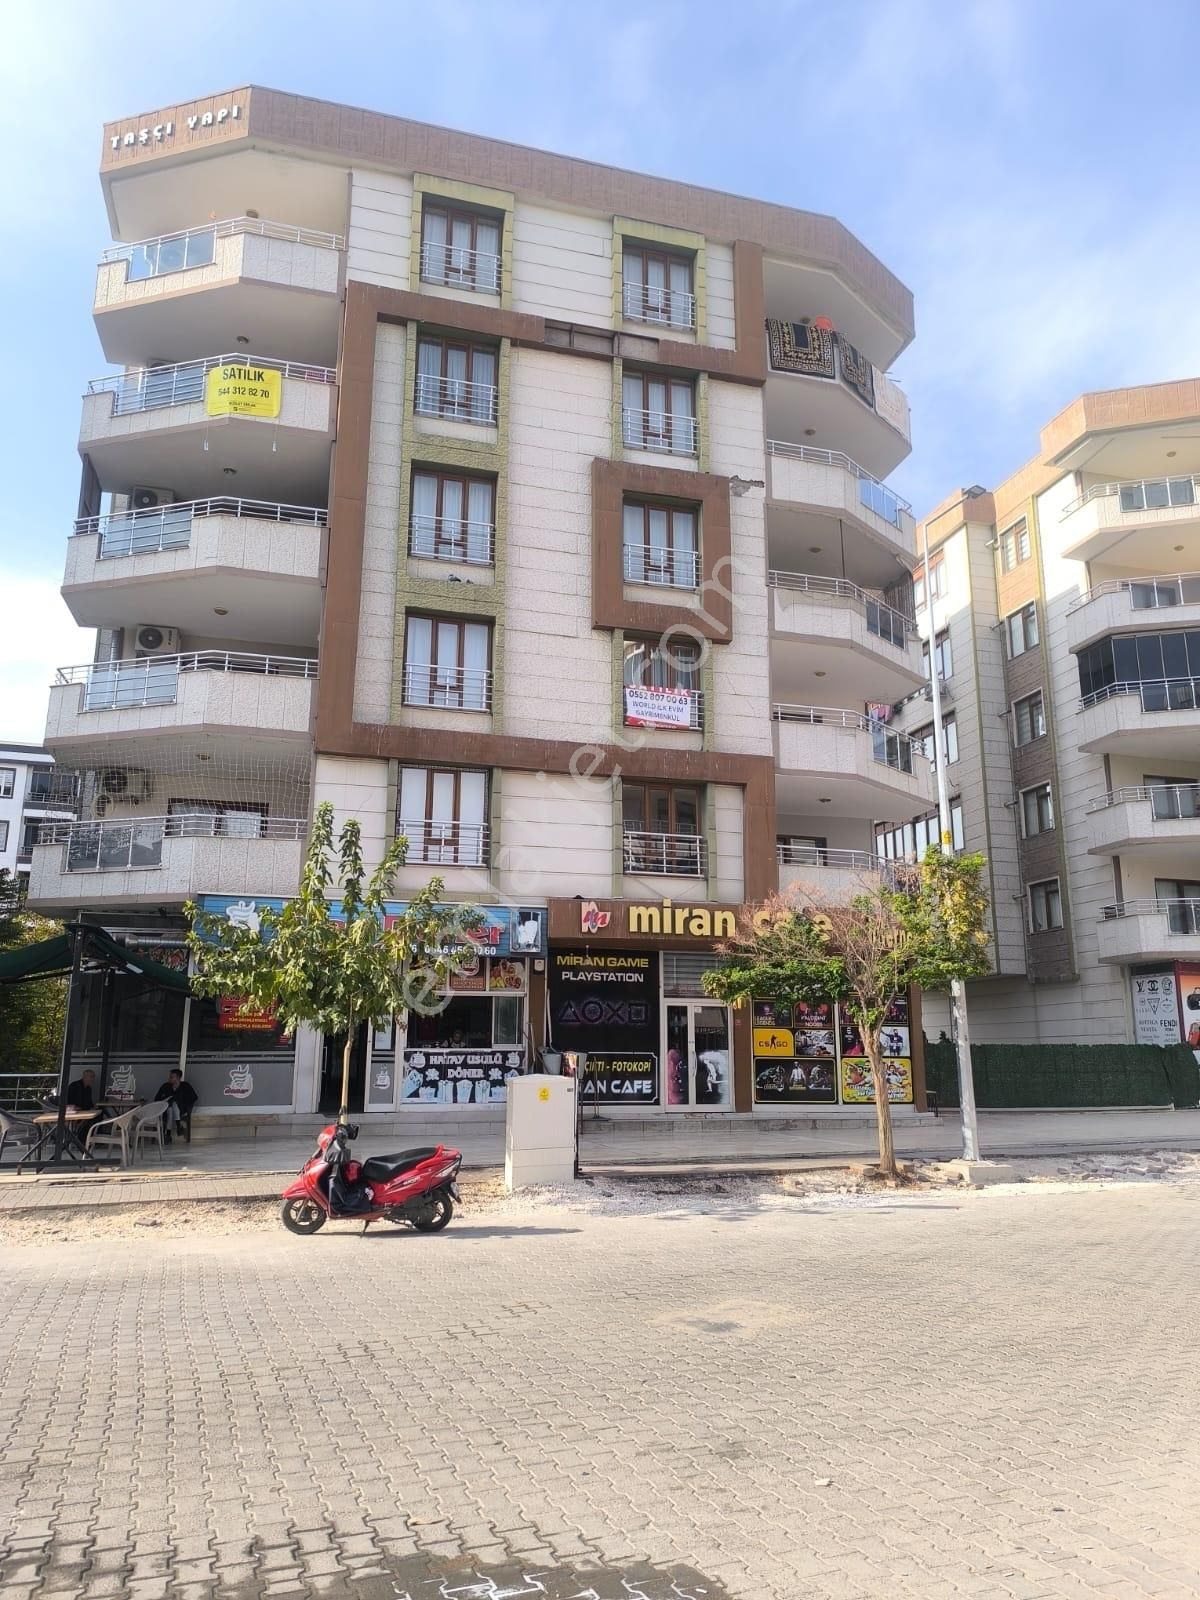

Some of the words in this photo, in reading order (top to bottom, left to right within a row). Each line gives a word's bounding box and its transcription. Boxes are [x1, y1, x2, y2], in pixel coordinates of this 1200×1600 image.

[110, 121, 173, 150] TAŞÇI
[187, 104, 240, 130] YAPI
[222, 367, 265, 382] SATILIK
[232, 386, 247, 395] 312
[260, 389, 270, 399] 70
[628, 689, 648, 699] 0552
[649, 693, 665, 702] 807
[678, 697, 688, 706] 63
[632, 700, 657, 710] WORLD
[628, 898, 736, 938] miran
[752, 905, 834, 943] cae
[556, 953, 605, 967] MİRAN
[606, 957, 649, 968] GAME
[561, 971, 644, 983] PLAYSTATION
[1160, 1019, 1178, 1028] FENDI
[429, 1055, 466, 1065] HATAY
[611, 1059, 652, 1072] FOTOKOPİ
[447, 1066, 485, 1079] DÖNER
[610, 1079, 653, 1094] CAFE
